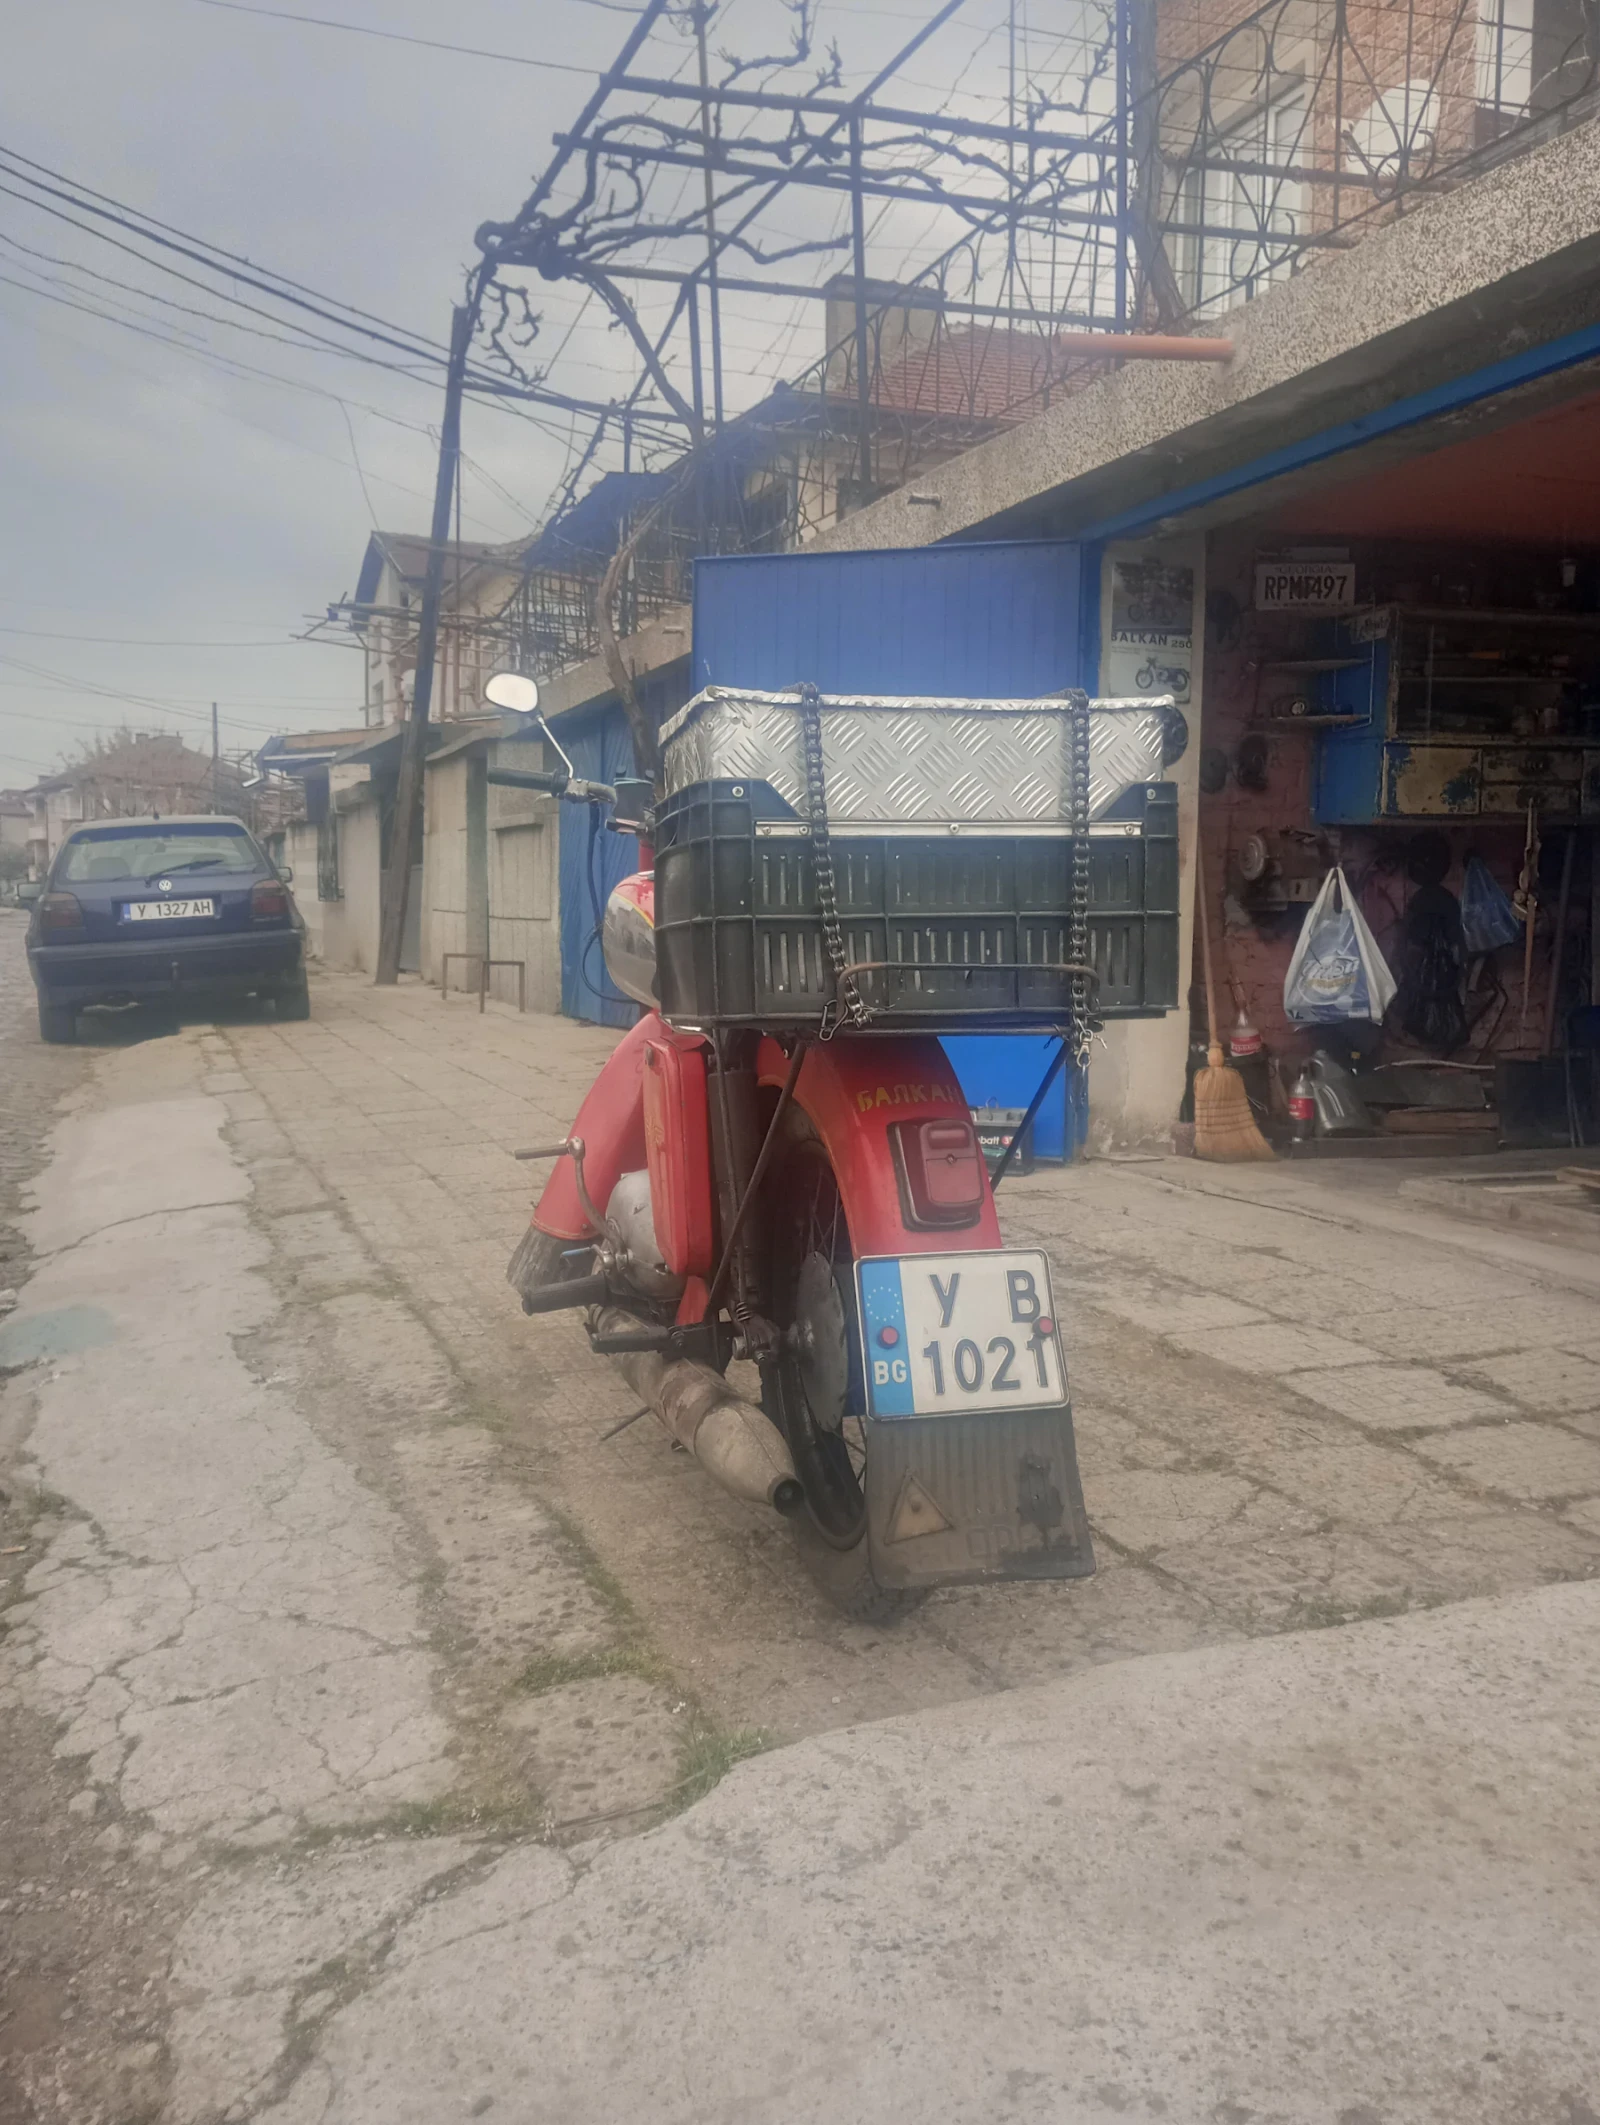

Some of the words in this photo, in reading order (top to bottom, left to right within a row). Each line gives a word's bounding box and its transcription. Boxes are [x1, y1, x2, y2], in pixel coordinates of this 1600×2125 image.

[156, 902, 189, 917] 1327
[873, 1359, 907, 1385] BG
[923, 1336, 1049, 1396] 1021
